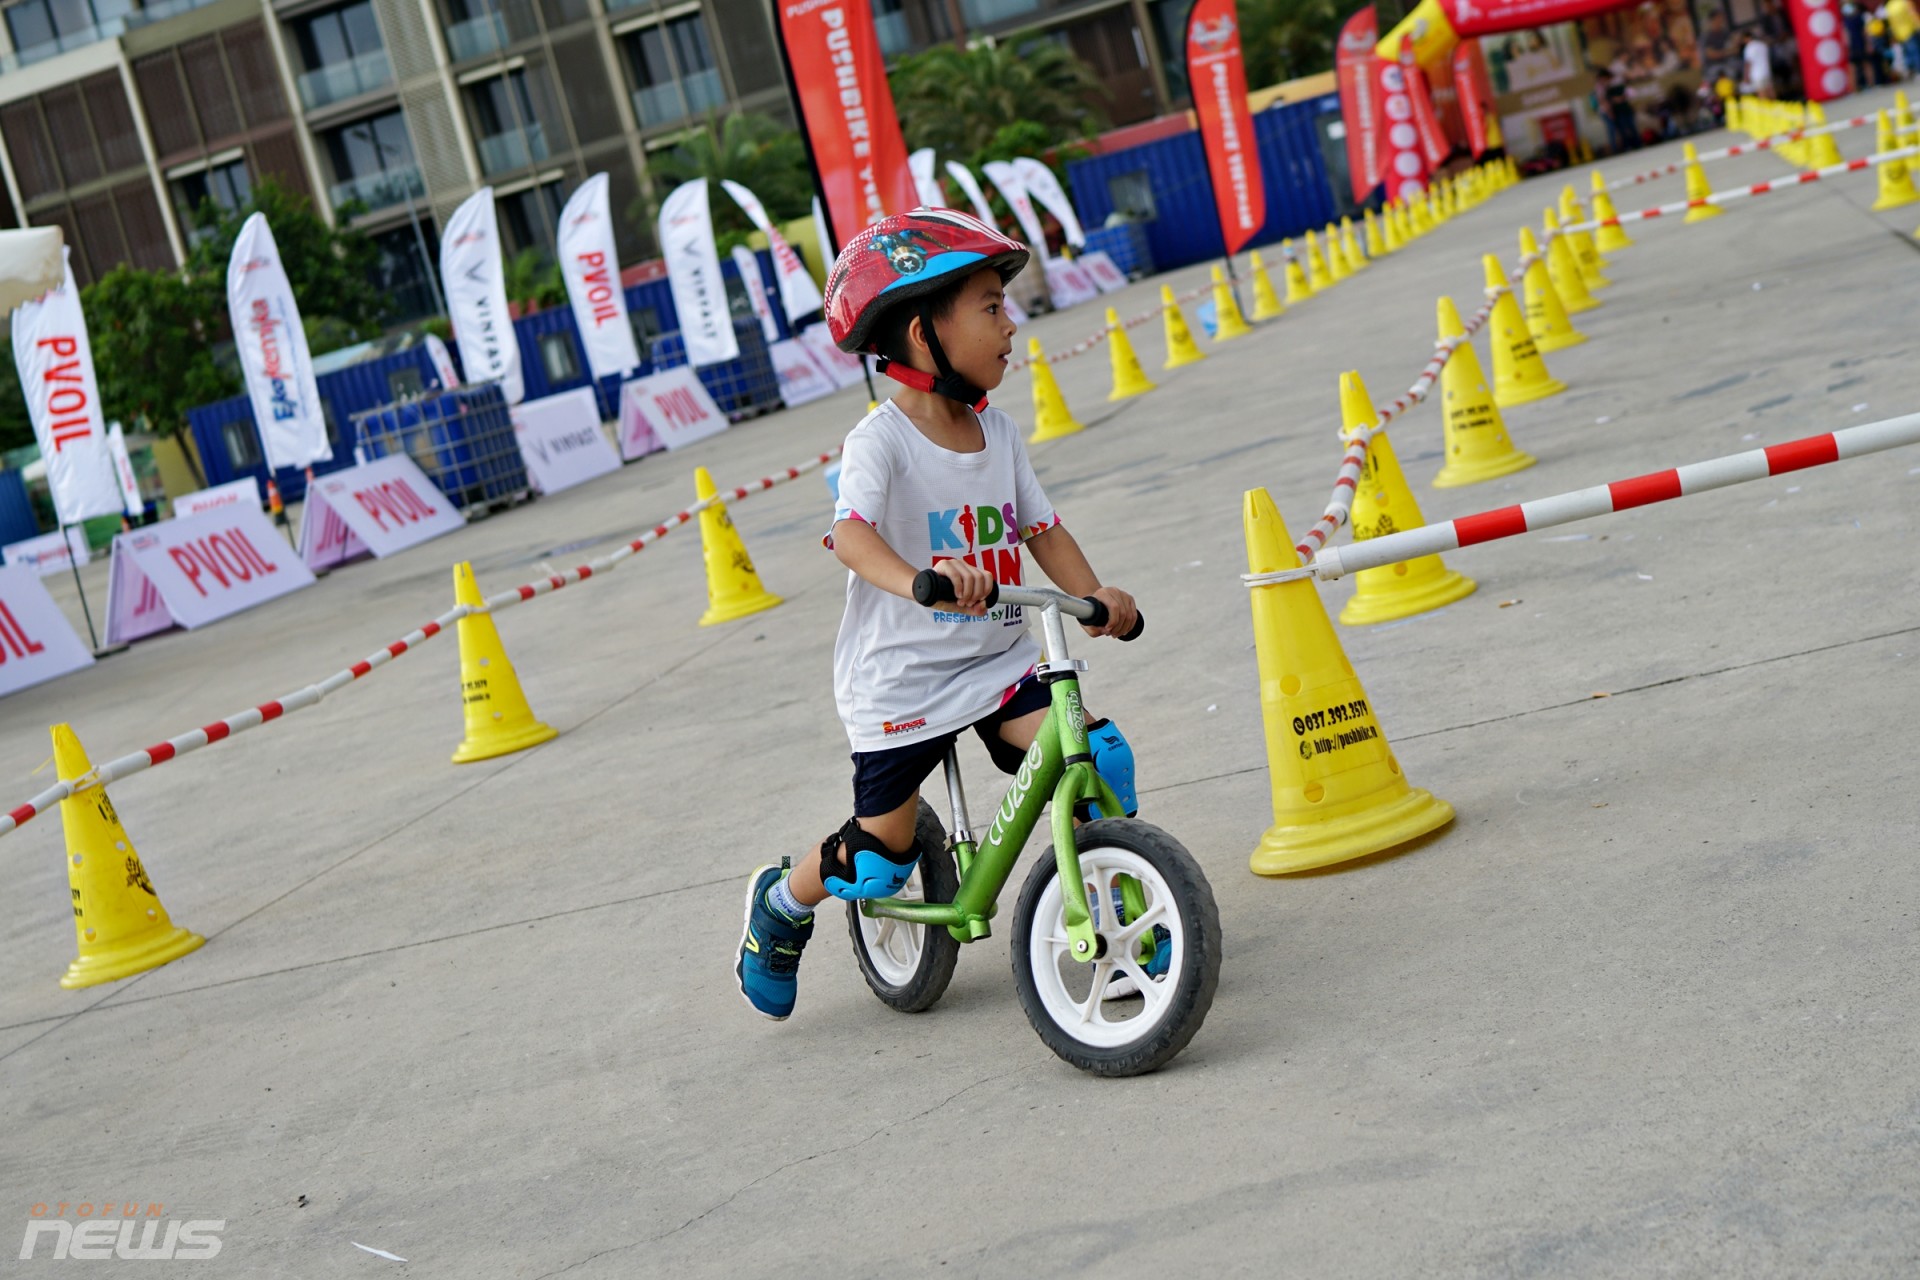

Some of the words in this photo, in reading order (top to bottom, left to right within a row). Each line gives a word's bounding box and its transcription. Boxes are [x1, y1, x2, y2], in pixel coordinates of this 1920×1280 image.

[821, 7, 871, 158] PUSHBIKE
[577, 250, 619, 328] PVOIL
[37, 336, 92, 453] PVOIL
[353, 477, 438, 534] PVOIL
[168, 526, 278, 597] PVOIL
[991, 608, 1005, 621] BY
[989, 740, 1044, 846] cruzee
